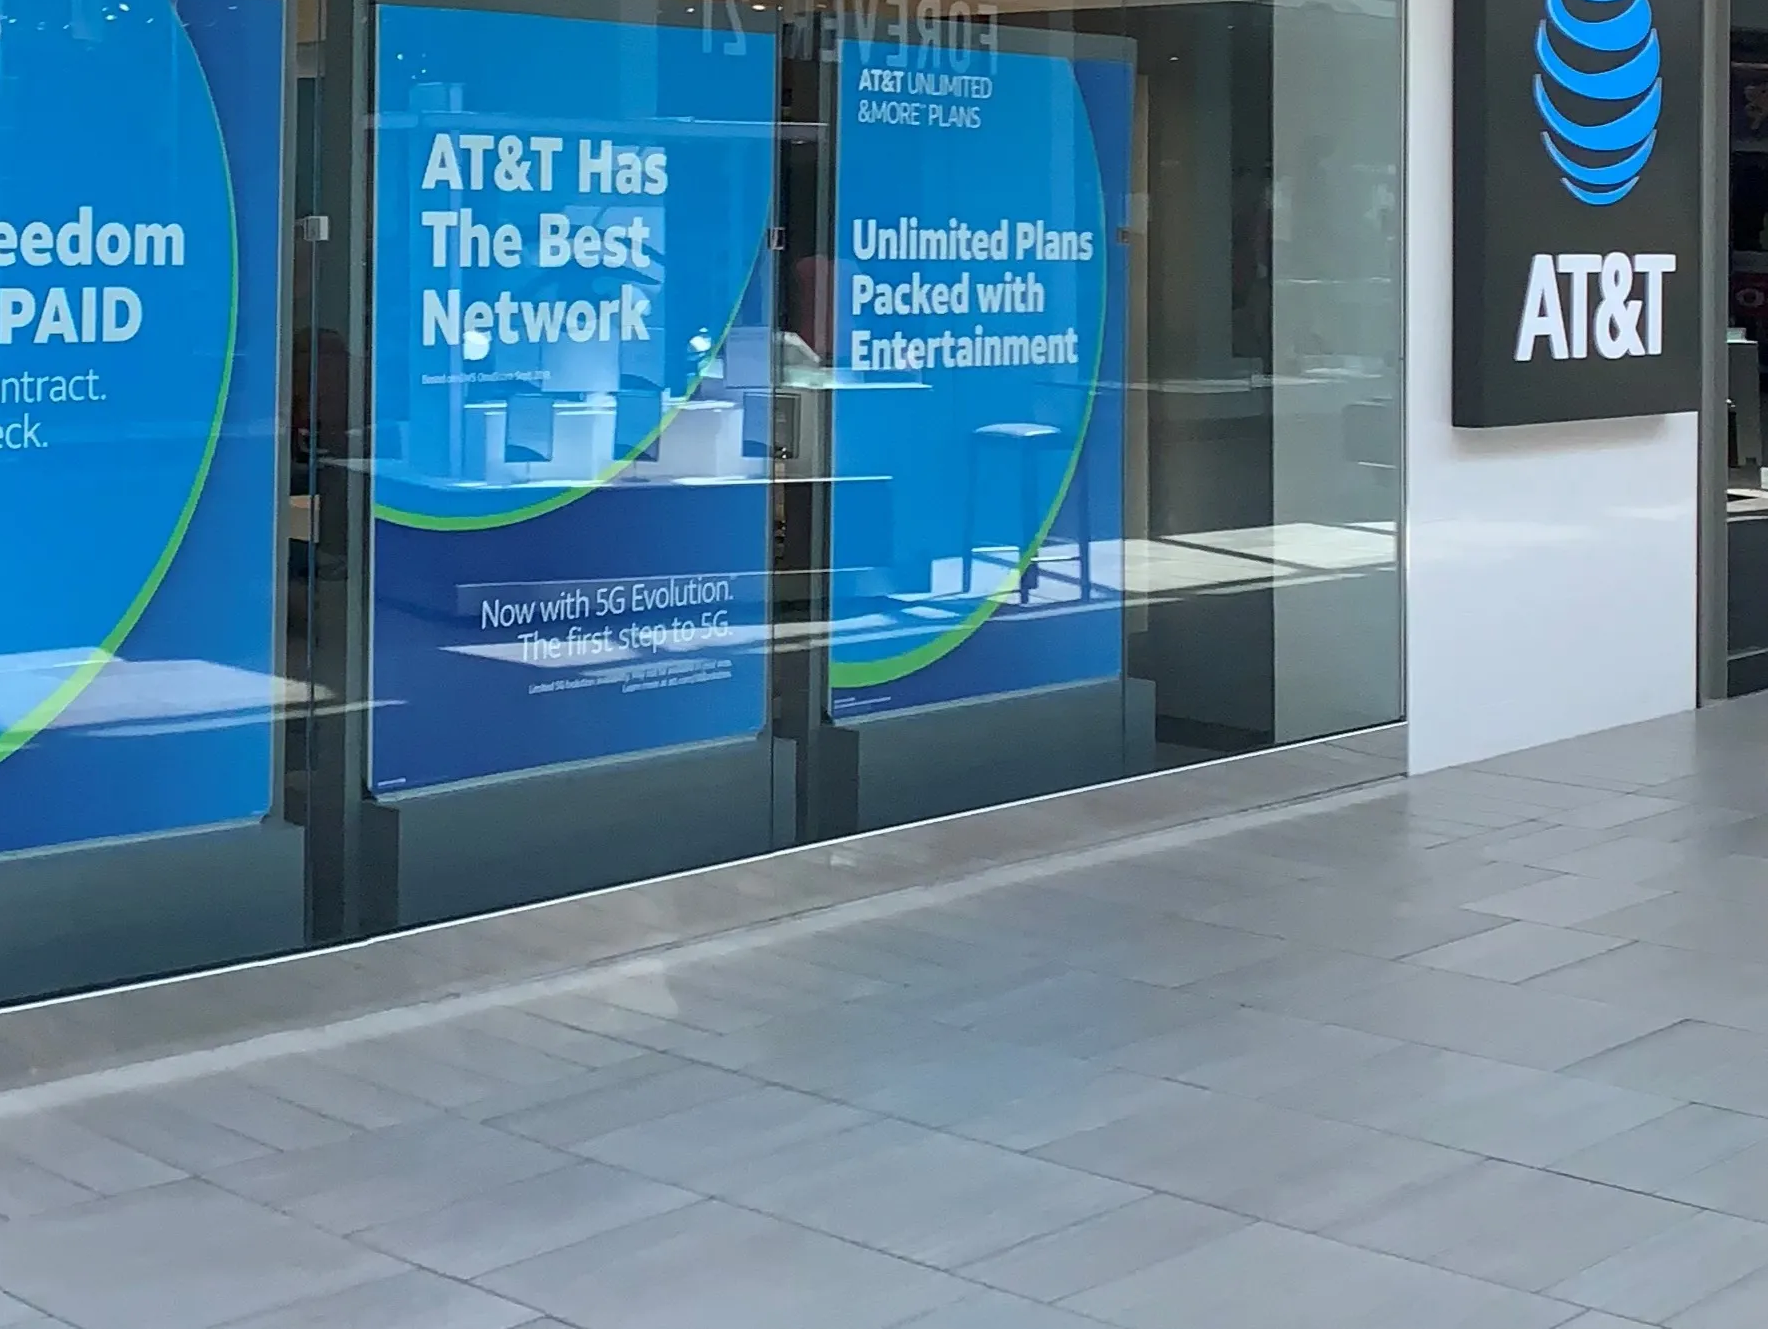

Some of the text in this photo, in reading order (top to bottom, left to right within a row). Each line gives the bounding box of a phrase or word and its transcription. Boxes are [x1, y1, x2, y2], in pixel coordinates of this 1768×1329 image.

[858, 68, 993, 100] AT&T UNLIMITED
[927, 104, 981, 130] PLANS
[422, 133, 668, 196] AT&T Has
[422, 208, 652, 270] The Best
[852, 217, 1094, 261] Unlimited Plans
[423, 284, 651, 346] Network
[851, 272, 1045, 317] Packed with
[1514, 252, 1676, 361] AT&T
[851, 326, 1078, 370] Entertainment
[481, 597, 535, 629] Now
[540, 591, 591, 625] with
[596, 586, 627, 618] 5G
[517, 610, 733, 662] The first step to 5G.
